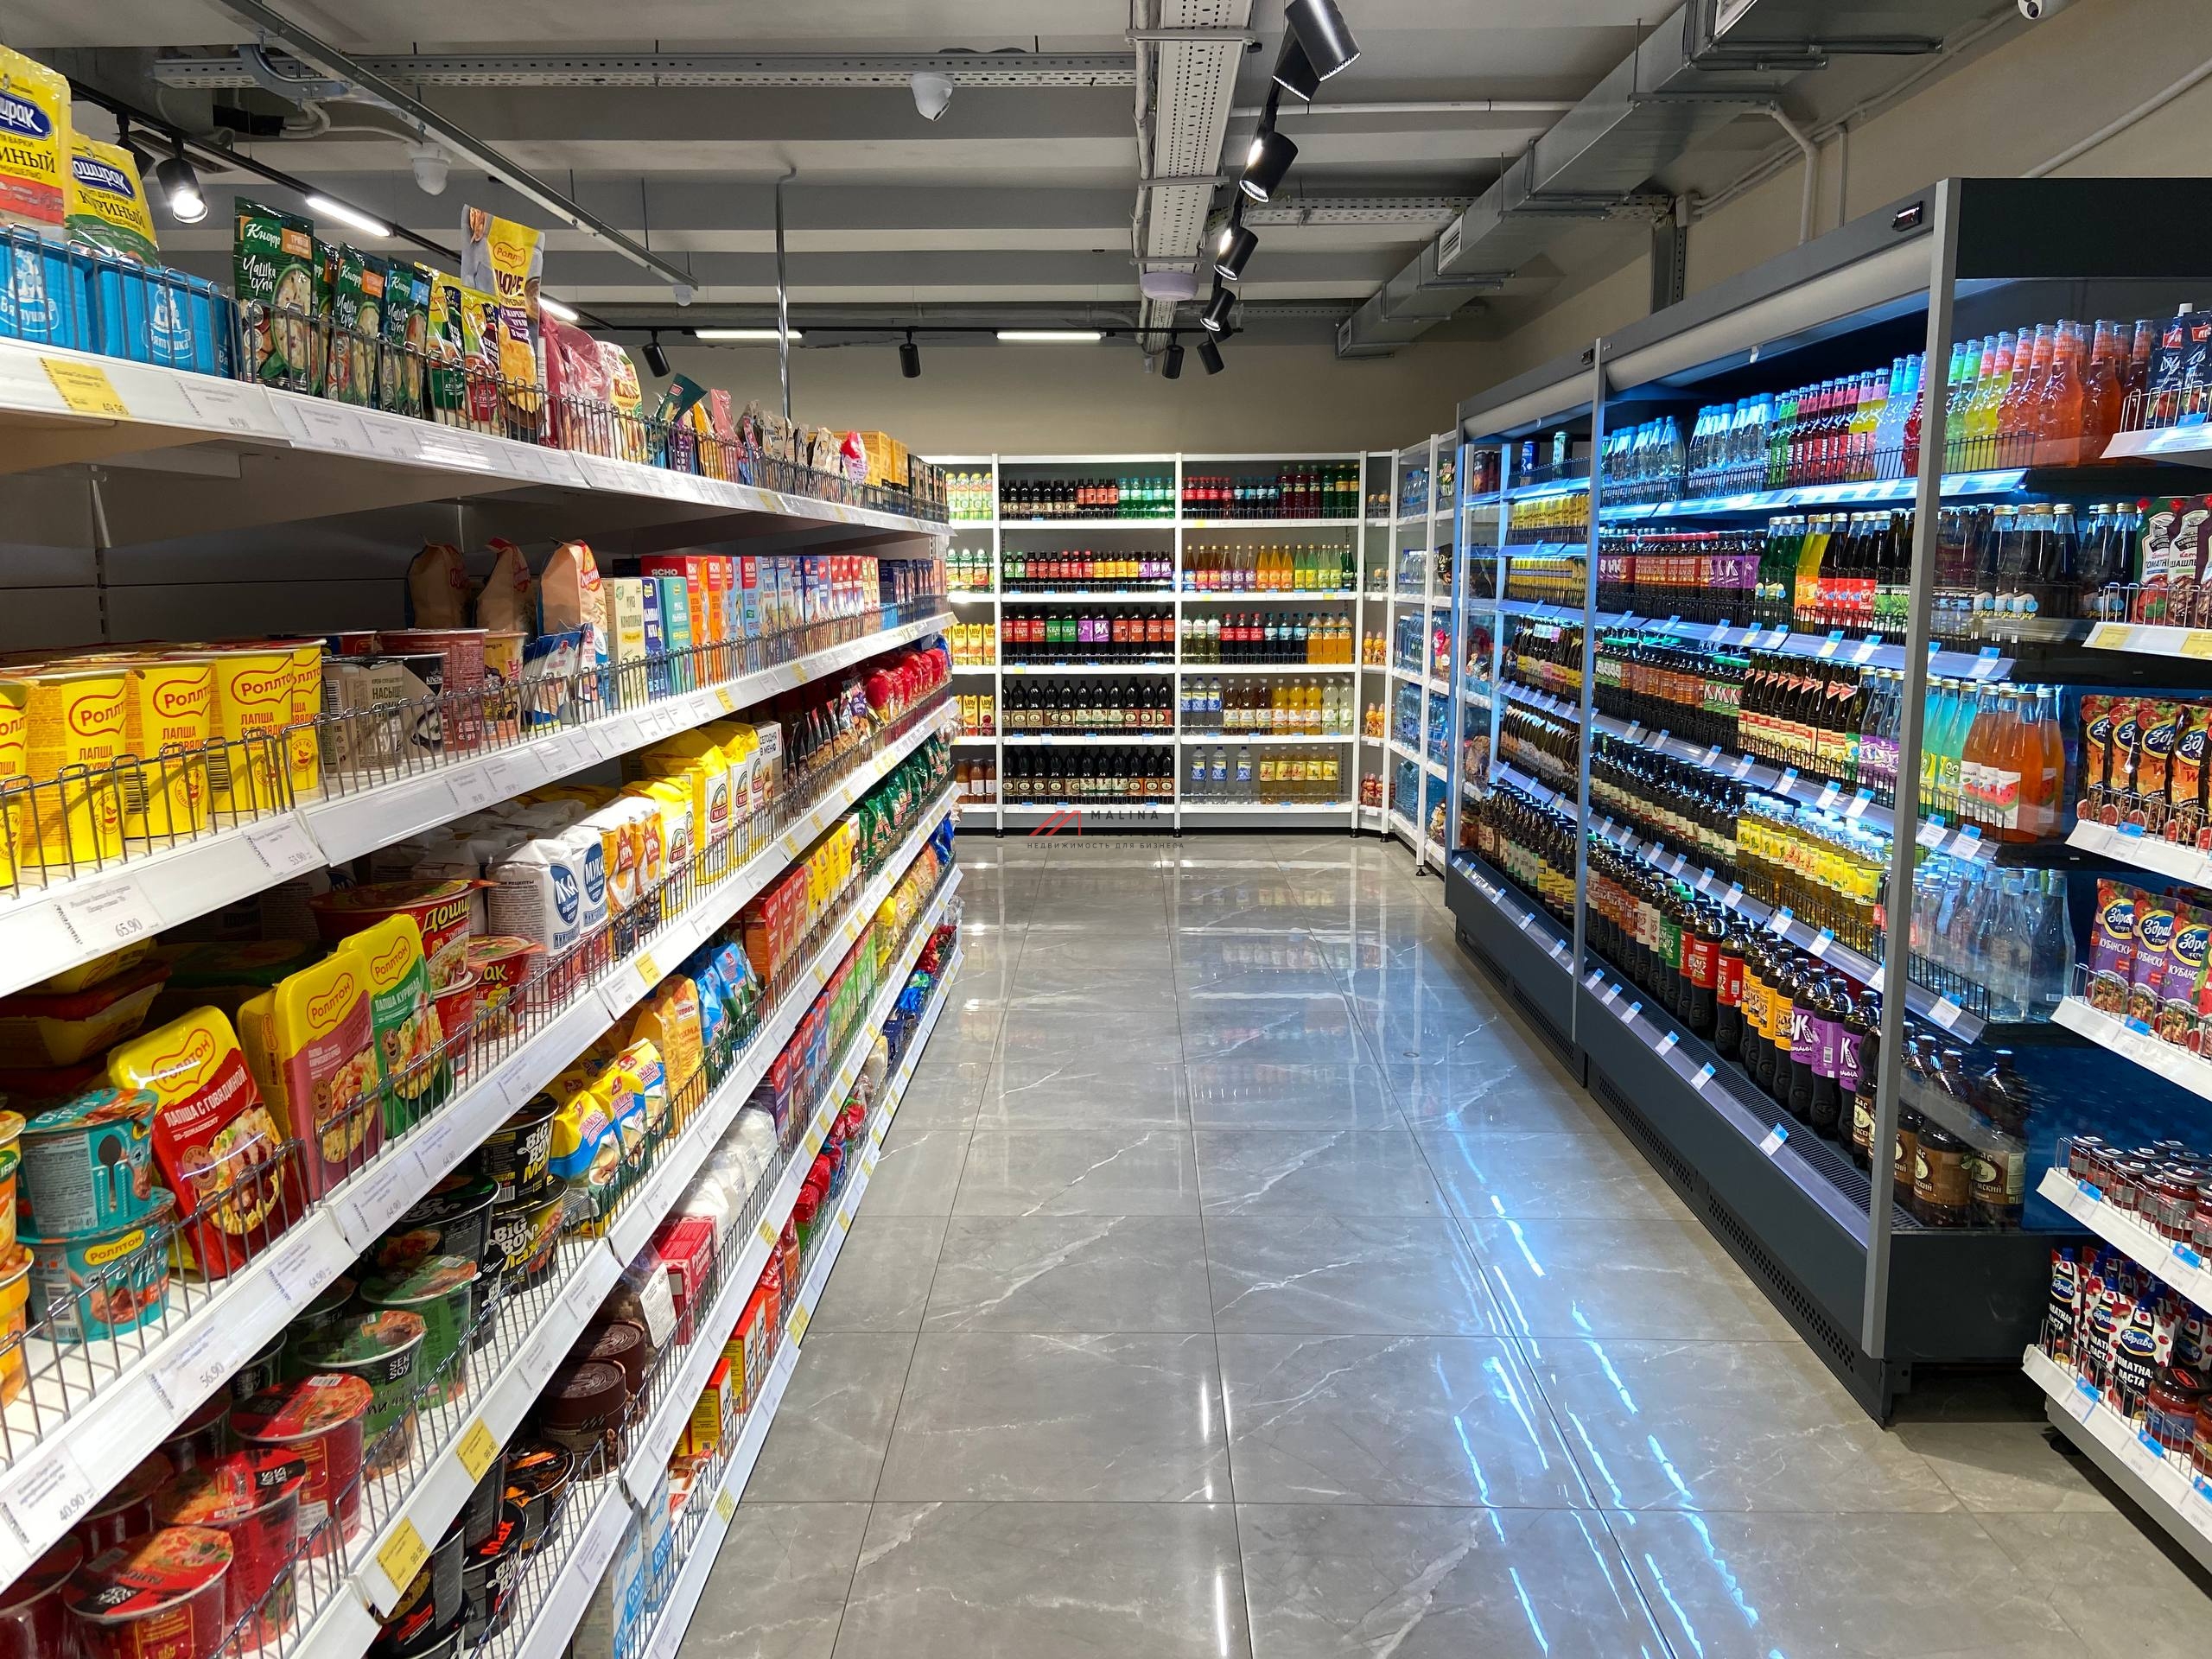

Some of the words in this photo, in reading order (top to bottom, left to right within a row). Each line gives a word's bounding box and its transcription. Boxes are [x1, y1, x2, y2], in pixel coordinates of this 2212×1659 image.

[245, 223, 281, 249] Кнорр
[243, 254, 276, 281] Чашка
[251, 276, 274, 297] супа
[241, 714, 274, 725] ЛАПША
[162, 728, 197, 741] ЛАПША
[78, 746, 113, 760] ЛАПША
[115, 917, 143, 938] 65.90
[374, 945, 408, 977] Роллтон
[311, 983, 351, 1020] Роллтон
[375, 995, 397, 1011] ЛАПША
[159, 1039, 210, 1084] Роллтон
[164, 1105, 197, 1128] ЛАПША
[204, 1065, 248, 1109] ГОВЯДИНОЙ
[525, 1122, 550, 1149] BiG
[493, 1217, 528, 1243] BiG
[500, 1224, 539, 1255] BON
[90, 1232, 143, 1262] Роллтон
[2121, 1329, 2154, 1350] Здрава
[200, 1362, 226, 1389] 56.90
[390, 1363, 410, 1382] SOY
[2118, 1368, 2145, 1389] ПАСТА
[58, 1493, 86, 1522] 40.90
